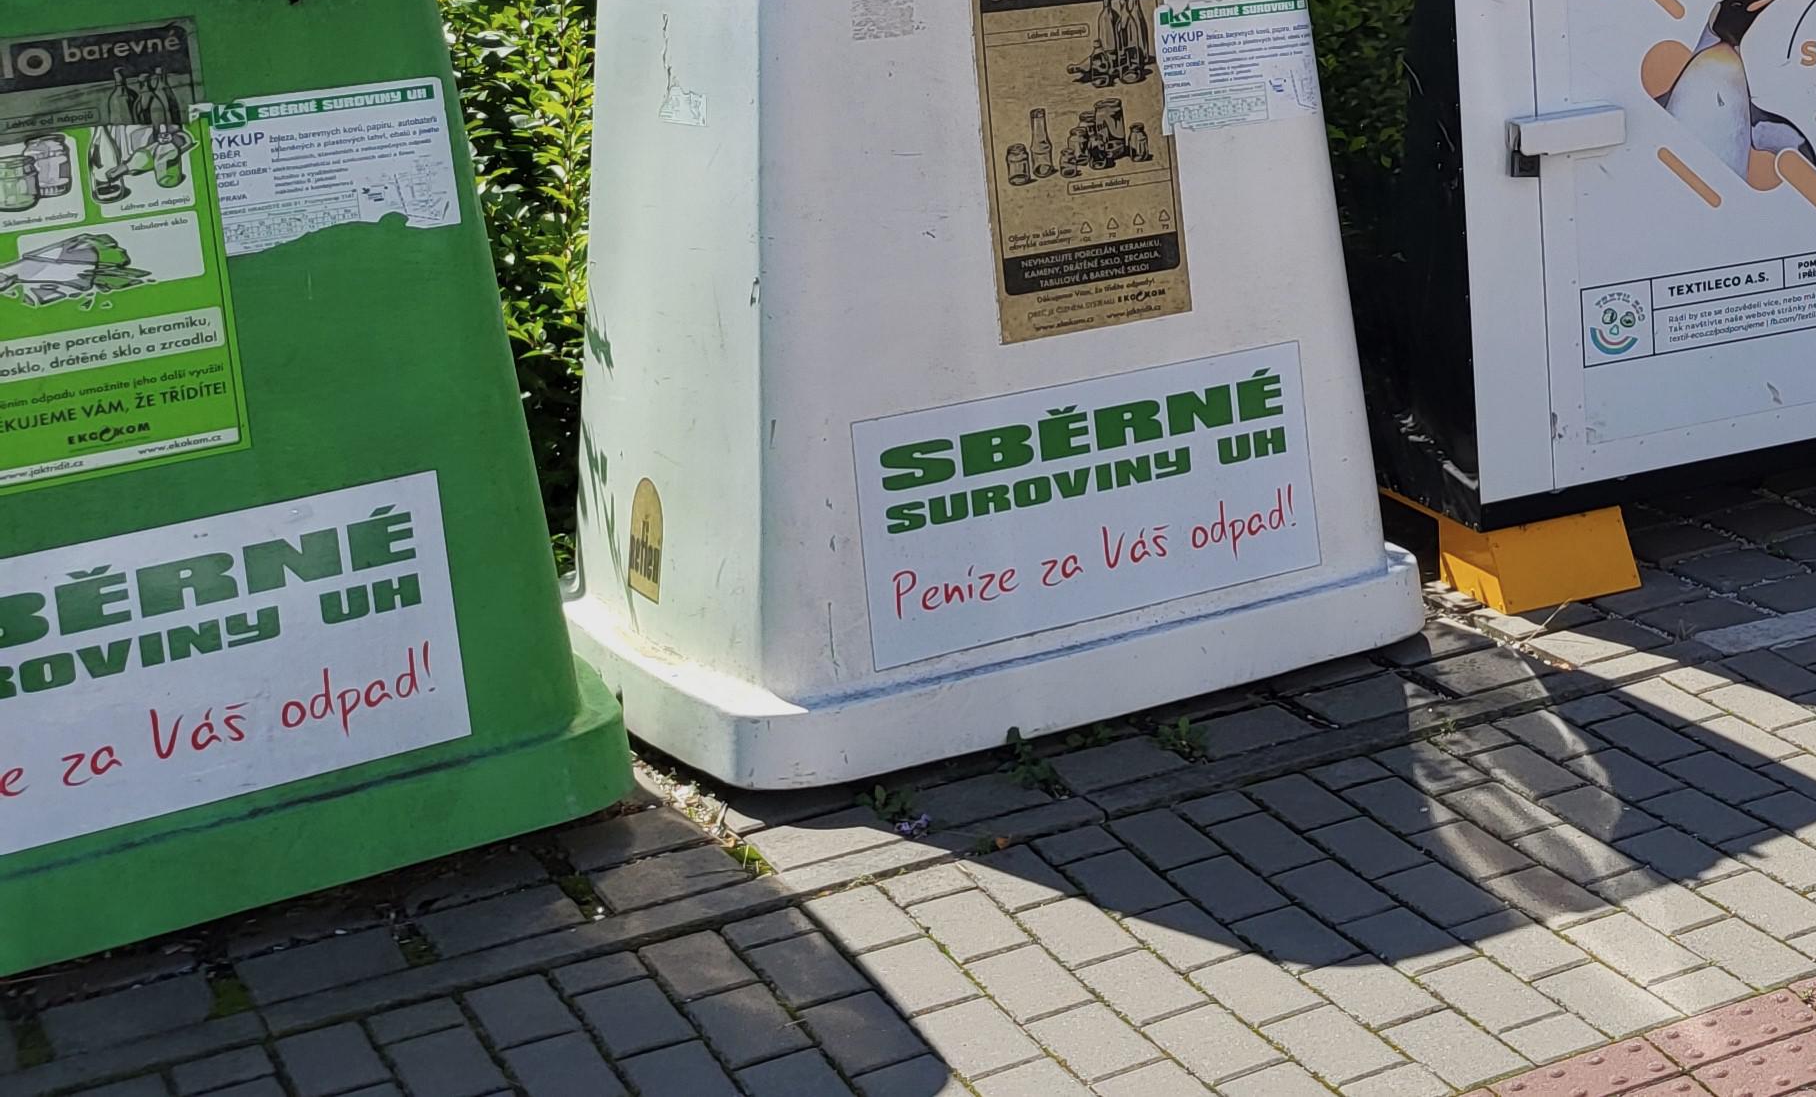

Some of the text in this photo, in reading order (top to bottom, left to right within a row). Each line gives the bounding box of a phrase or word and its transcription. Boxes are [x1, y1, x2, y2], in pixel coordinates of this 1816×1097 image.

[1200, 0, 1295, 20] SBĚRNÉ SUROVINY
[61, 30, 181, 62] barevné
[1162, 30, 1203, 45] VÝKUP
[1162, 46, 1187, 54] ODBĚR
[258, 87, 427, 118] SBĚRNÉ SUROVINY UH
[211, 131, 265, 149] ÝKUP
[213, 149, 241, 160] DBĚR
[218, 180, 240, 189] ODEJ
[220, 194, 248, 203] PRAVA
[130, 217, 188, 231] Tabulové sklo
[1021, 252, 1072, 268] NEVHAZUJTE
[1040, 273, 1080, 287] TABULOVÉ
[1082, 273, 1088, 281] A
[1090, 266, 1125, 279] BAREVNÉ
[1668, 272, 1769, 297] TEXTILECO A.S.
[1783, 295, 1802, 304] nebo
[0, 316, 211, 358] vhazujte porcelán, keramiku,
[0, 344, 155, 378] osklo, drátěné sklo a
[31, 389, 75, 404] odpadu
[133, 376, 157, 388] jeho
[160, 369, 186, 381] další
[0, 382, 227, 434] KUJEME VÁM, ŽE TŘÍDÍTE!
[880, 367, 1284, 492] SBĚRNÉ
[885, 426, 1287, 535] SUROVINY UH
[893, 483, 1297, 620] Peníze za Váš odpad!
[319, 573, 422, 624] UH
[62, 744, 123, 787] za
[150, 702, 248, 761] Váš
[281, 640, 437, 737] odpad!
